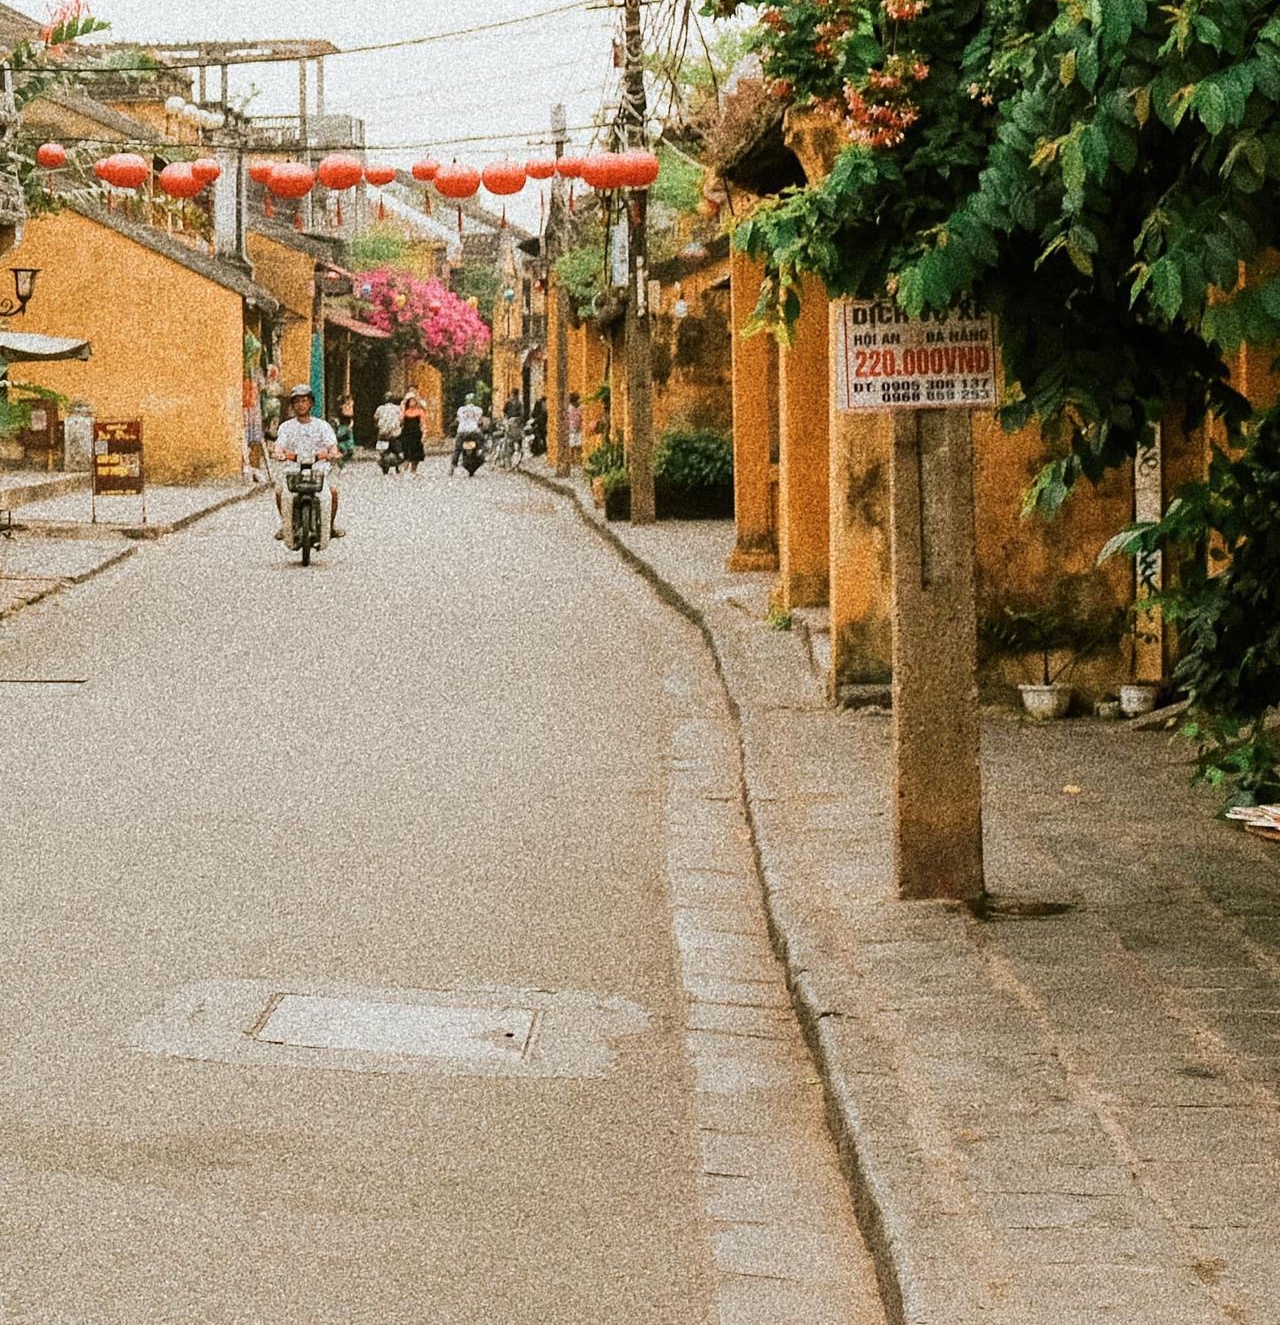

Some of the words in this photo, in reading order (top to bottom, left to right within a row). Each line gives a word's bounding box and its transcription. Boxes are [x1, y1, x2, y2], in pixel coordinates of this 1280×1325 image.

[854, 332, 877, 347] HỘI
[882, 333, 900, 344] AN
[881, 381, 920, 391] 0905
[961, 378, 989, 389] 137
[882, 392, 920, 402] 0968
